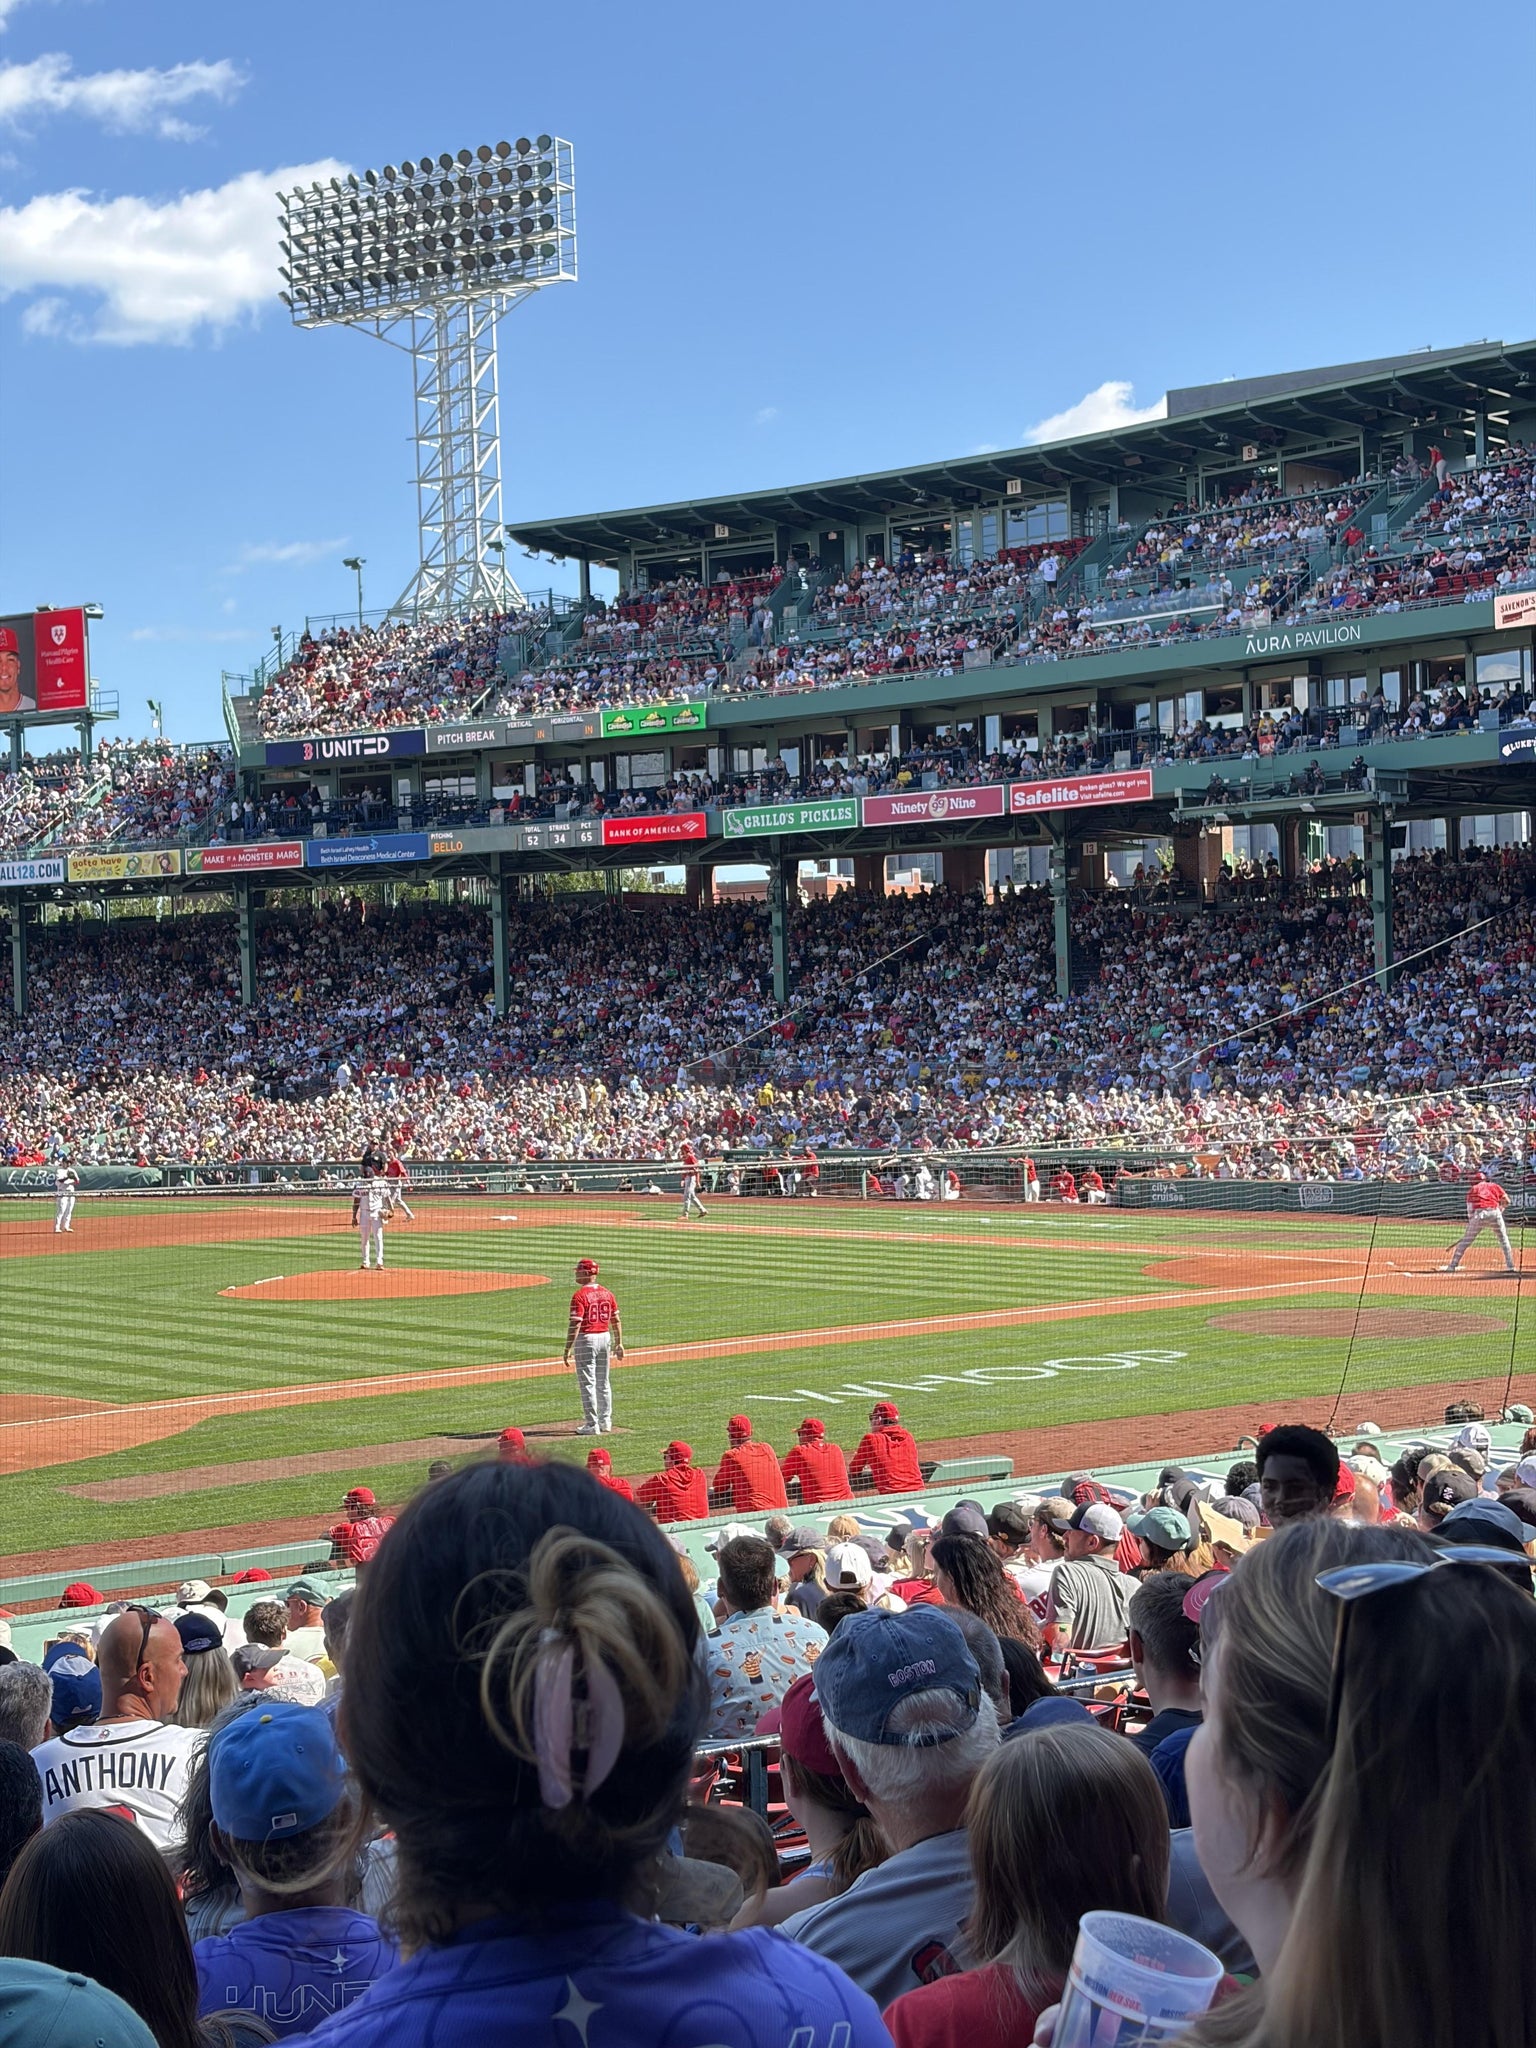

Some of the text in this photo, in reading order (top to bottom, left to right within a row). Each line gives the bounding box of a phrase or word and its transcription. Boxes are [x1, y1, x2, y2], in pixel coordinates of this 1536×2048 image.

[1247, 447, 1253, 458] 9
[1011, 481, 1018, 493] 11
[718, 526, 726, 536] 13
[1500, 596, 1536, 613] SAVENOR'S
[1295, 625, 1361, 648] PAVILION
[507, 720, 533, 729] VERTICAL
[550, 716, 584, 725] HORIZONTAL
[537, 729, 545, 739] IN
[584, 725, 593, 735] IN
[437, 730, 495, 745] PITCH BREAK
[322, 736, 390, 758] UNITED
[1079, 784, 1098, 792] Broken
[1126, 780, 1136, 788] got
[1014, 787, 1079, 807] Safelite
[1080, 790, 1125, 801] Visit safelite.com
[891, 802, 929, 815] Ninety
[949, 797, 976, 810] Nine
[744, 807, 852, 828] GRILLO'S PICKLES
[1357, 812, 1366, 822] 14
[548, 824, 570, 832] STRIKES
[609, 825, 681, 838] BANK OF AMERICA
[430, 832, 454, 840] PITCHING
[527, 836, 539, 846] 52
[554, 834, 566, 844] 34
[580, 832, 593, 842] 65
[433, 841, 463, 853] BELLO
[1086, 844, 1095, 854] 13
[204, 854, 225, 865] MAKE
[238, 852, 274, 862] MONSTER
[276, 850, 300, 860] MARG
[321, 850, 416, 863] Beth Israel Deaconess Medical Center
[72, 857, 122, 869] gotta have
[0, 863, 61, 881] ALL128.COM
[1151, 1182, 1168, 1193] city
[1151, 1193, 1184, 1202] cruises
[745, 1350, 1189, 1404] WHOOP
[887, 1659, 936, 1688] BOSTON
[45, 1751, 177, 1805] ANTHONY
